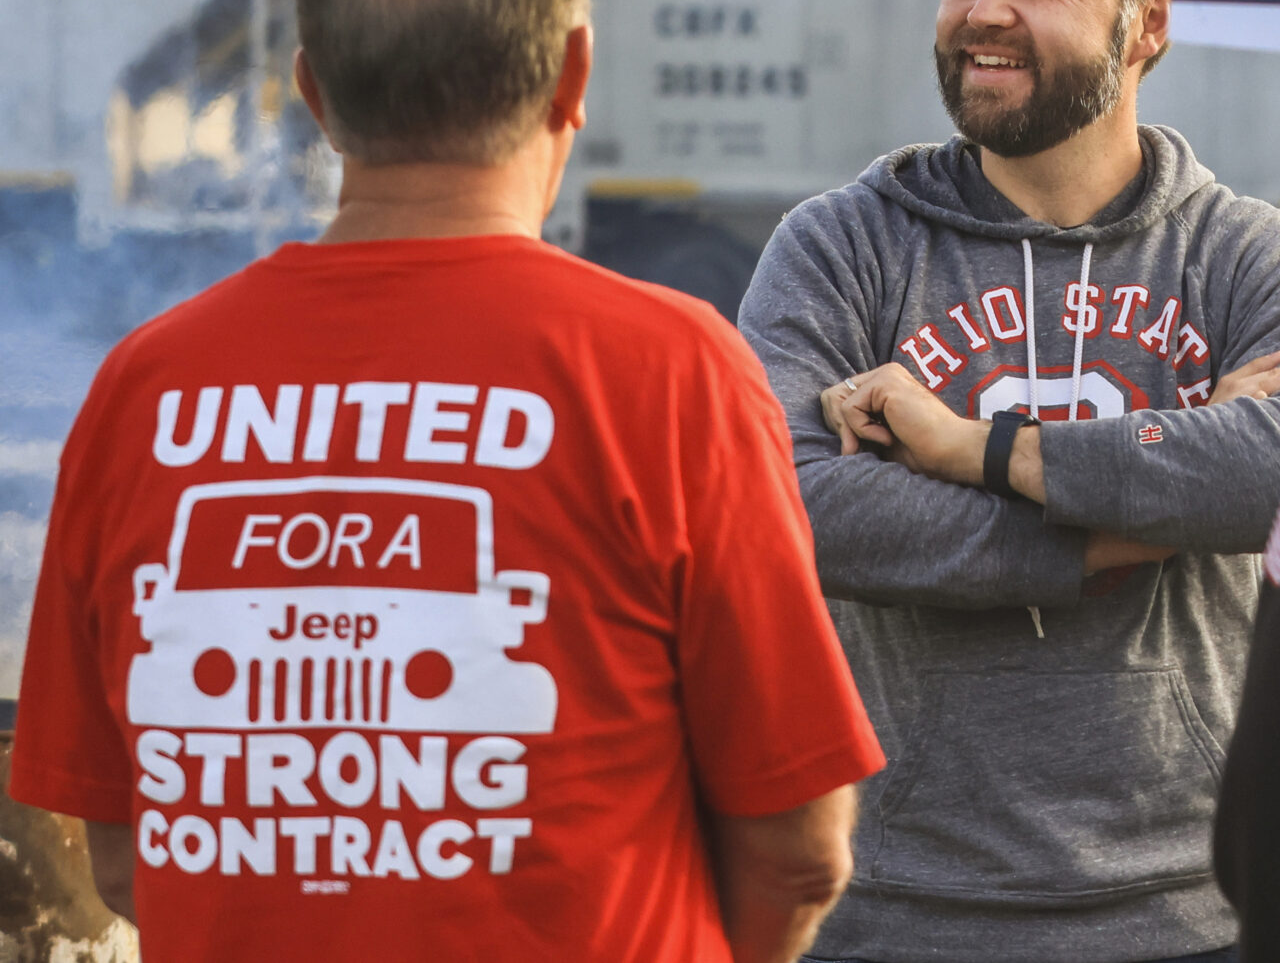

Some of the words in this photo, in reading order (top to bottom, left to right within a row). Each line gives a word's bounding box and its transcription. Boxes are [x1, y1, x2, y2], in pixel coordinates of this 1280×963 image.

[152, 381, 556, 470] UNITED
[232, 513, 372, 569] FOR
[377, 513, 422, 569] A
[269, 604, 379, 649] Jeep
[136, 729, 529, 810] STRONG
[138, 809, 533, 881] CONTRACT
